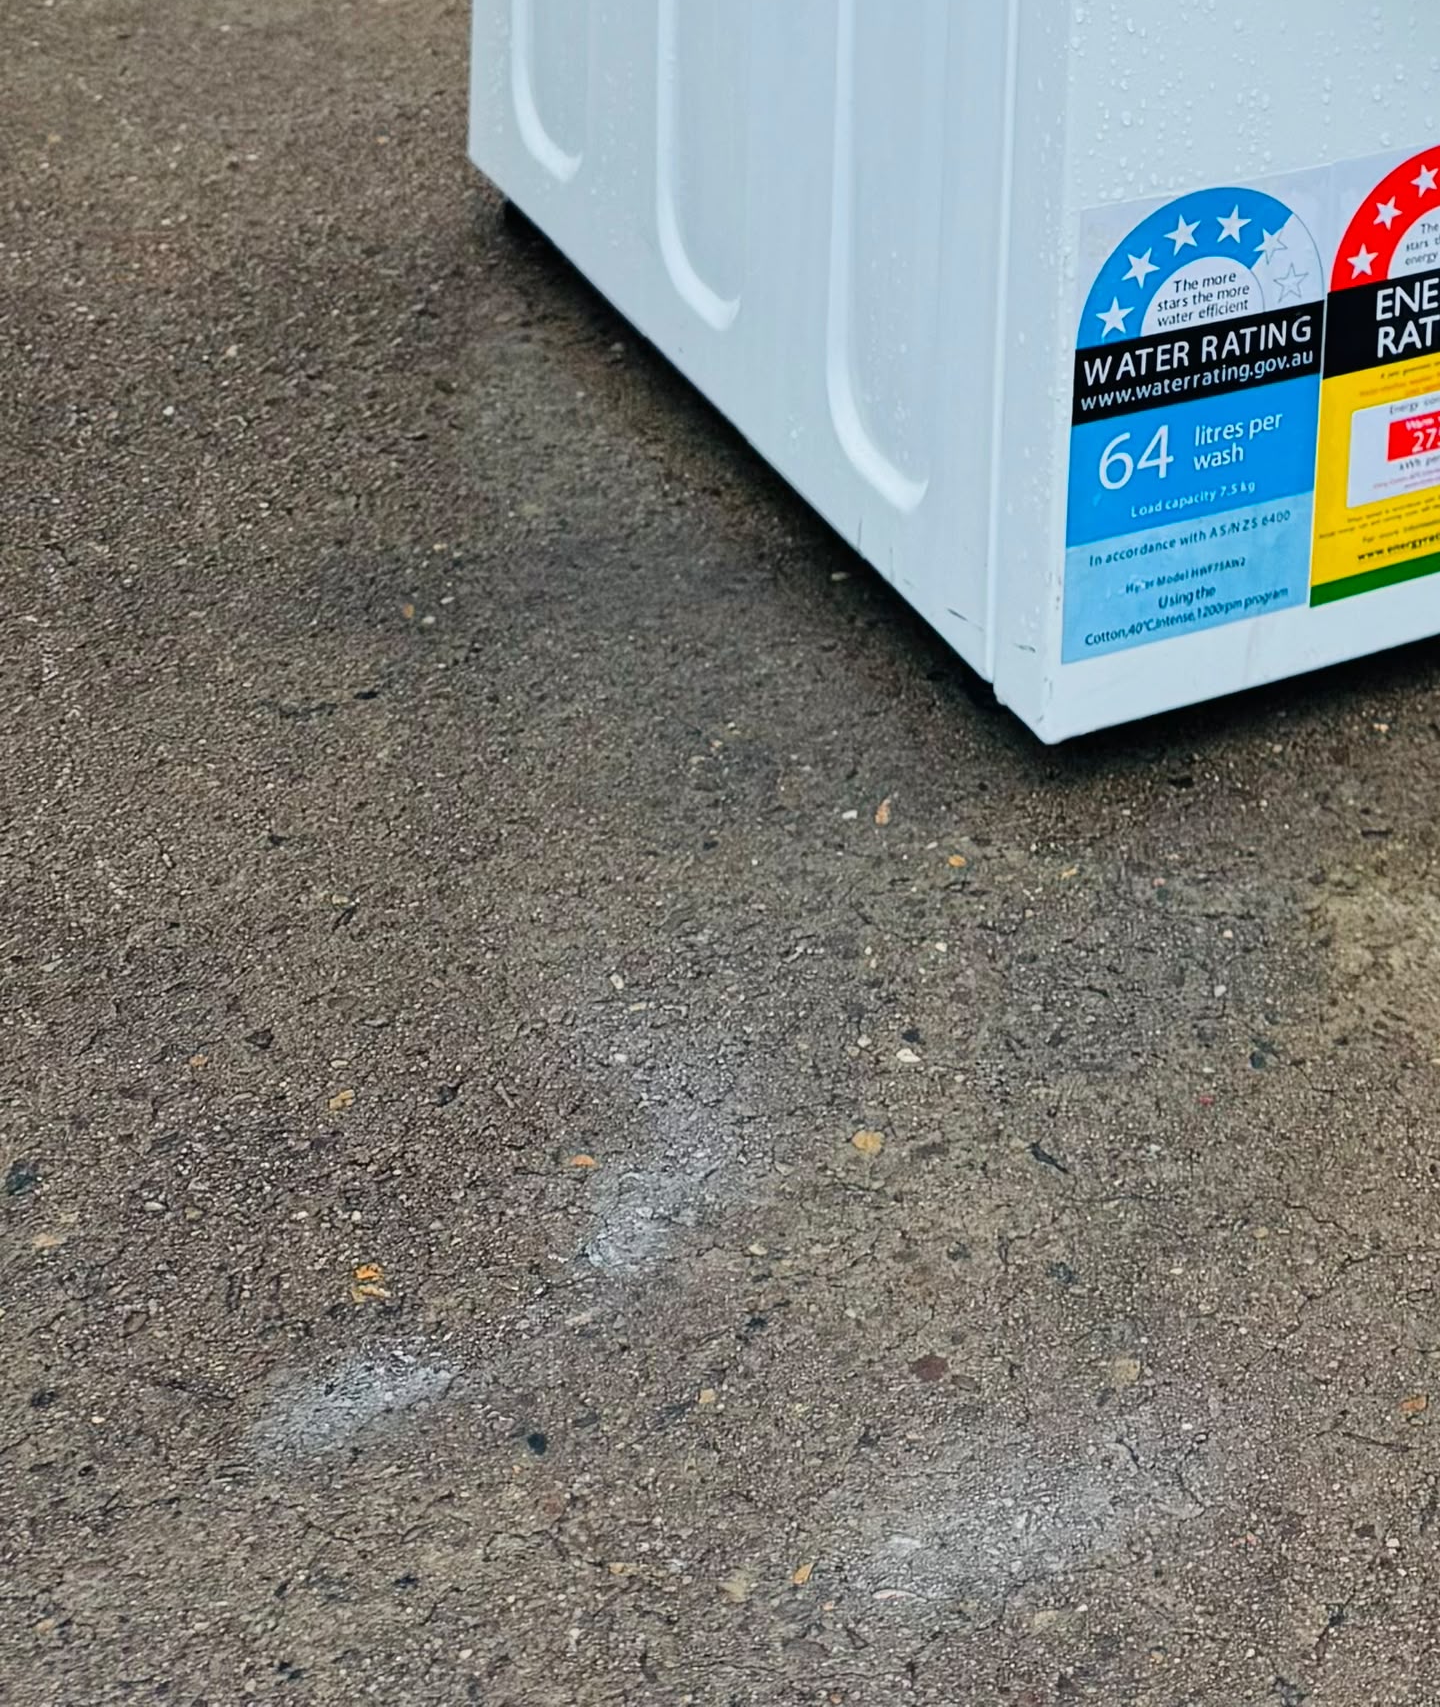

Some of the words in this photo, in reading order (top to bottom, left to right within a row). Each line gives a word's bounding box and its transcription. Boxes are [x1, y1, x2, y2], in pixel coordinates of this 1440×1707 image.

[1420, 223, 1440, 234] The
[1405, 240, 1429, 253] stars
[1405, 251, 1439, 266] energy
[1173, 278, 1199, 294] The
[1202, 272, 1237, 288] more
[1157, 296, 1188, 312] stars
[1192, 291, 1214, 306] the
[1216, 284, 1251, 301] more
[1156, 312, 1193, 328] water
[1197, 299, 1249, 319] efficient
[1083, 340, 1190, 387] WATER
[1201, 315, 1313, 364] RATING
[1080, 350, 1314, 412] www.waterrating.gov.au
[1098, 424, 1175, 491] 64
[1195, 422, 1244, 447] litres
[1248, 413, 1283, 440] per
[1193, 442, 1244, 470] wash
[1131, 499, 1162, 518] Load
[1165, 489, 1216, 510] capacity
[1219, 485, 1238, 497] 7.5
[1089, 554, 1103, 567] In
[1105, 537, 1177, 563] accordance
[1179, 531, 1207, 547] with
[1261, 509, 1291, 527] 6400
[1125, 579, 1154, 594] Her
[1156, 568, 1189, 587] Model
[1158, 591, 1194, 609] Using
[1195, 585, 1216, 600] the
[1243, 587, 1289, 610] program
